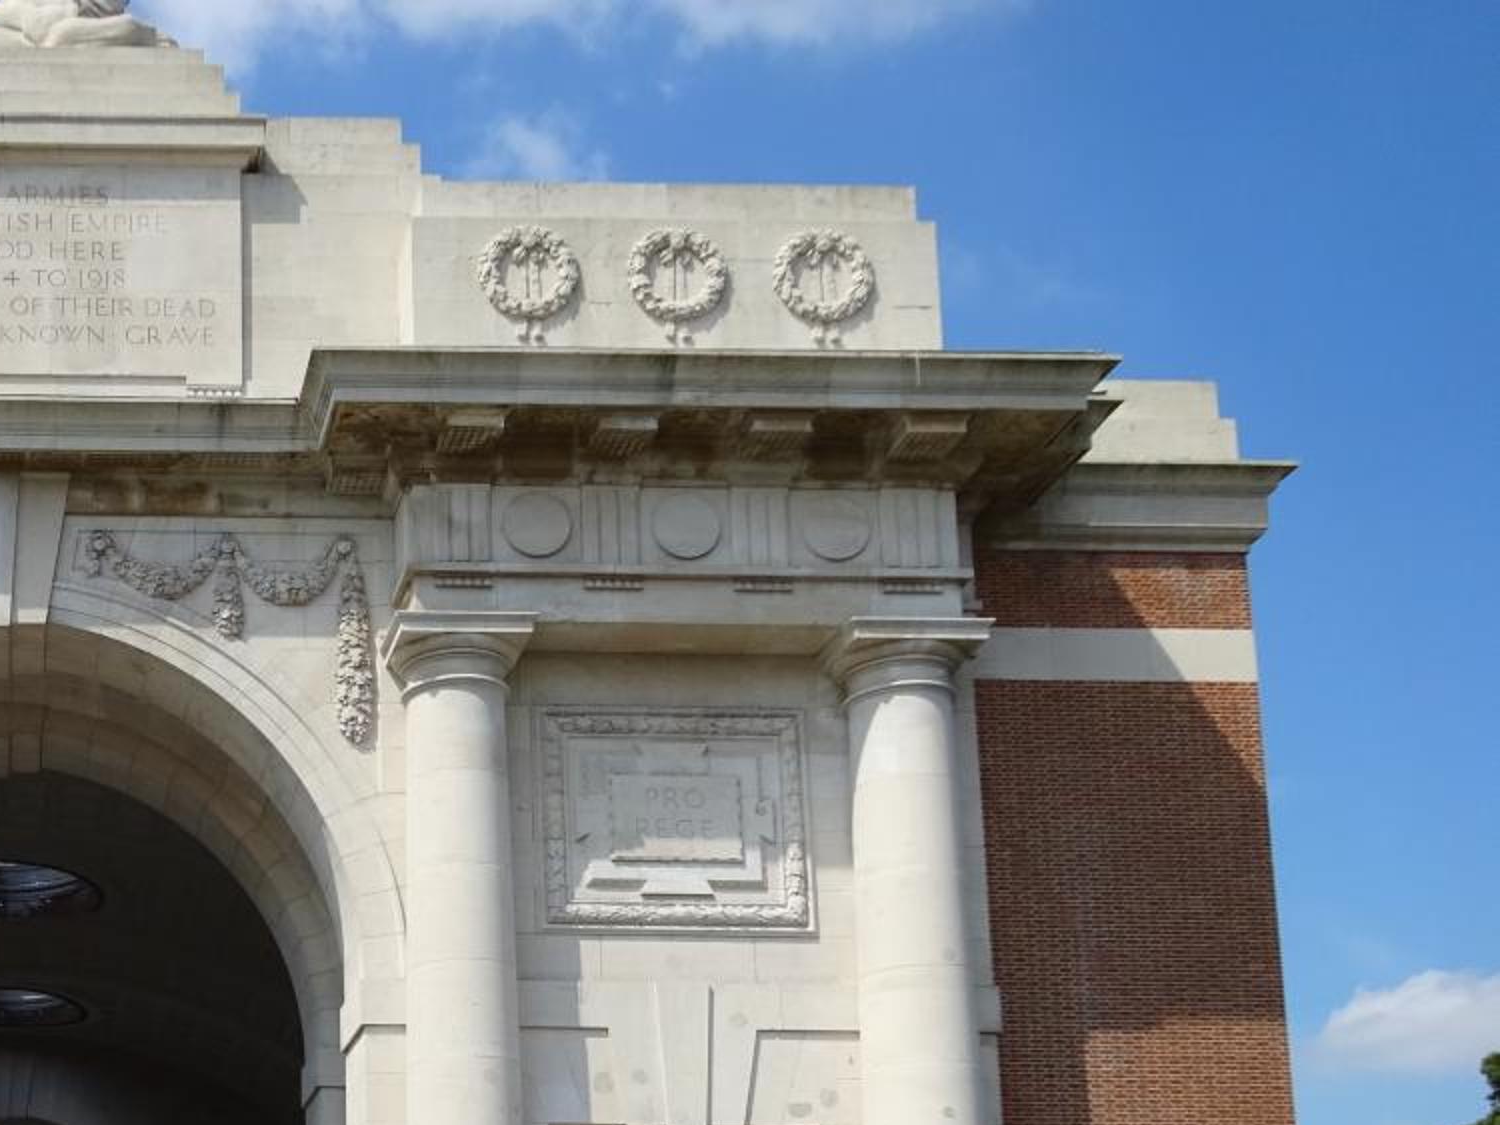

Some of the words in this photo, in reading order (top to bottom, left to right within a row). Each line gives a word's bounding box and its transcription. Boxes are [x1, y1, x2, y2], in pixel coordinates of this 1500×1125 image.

[5, 184, 109, 206] ARMIES
[49, 241, 125, 262] HERE
[32, 268, 67, 288] TO
[78, 268, 126, 289] 1918
[9, 296, 43, 317] OF
[53, 297, 133, 318] THEIR
[145, 298, 217, 319] DEAD
[0, 324, 105, 345] KNOWN
[125, 325, 215, 346] GRAVE
[644, 786, 707, 809] PRO
